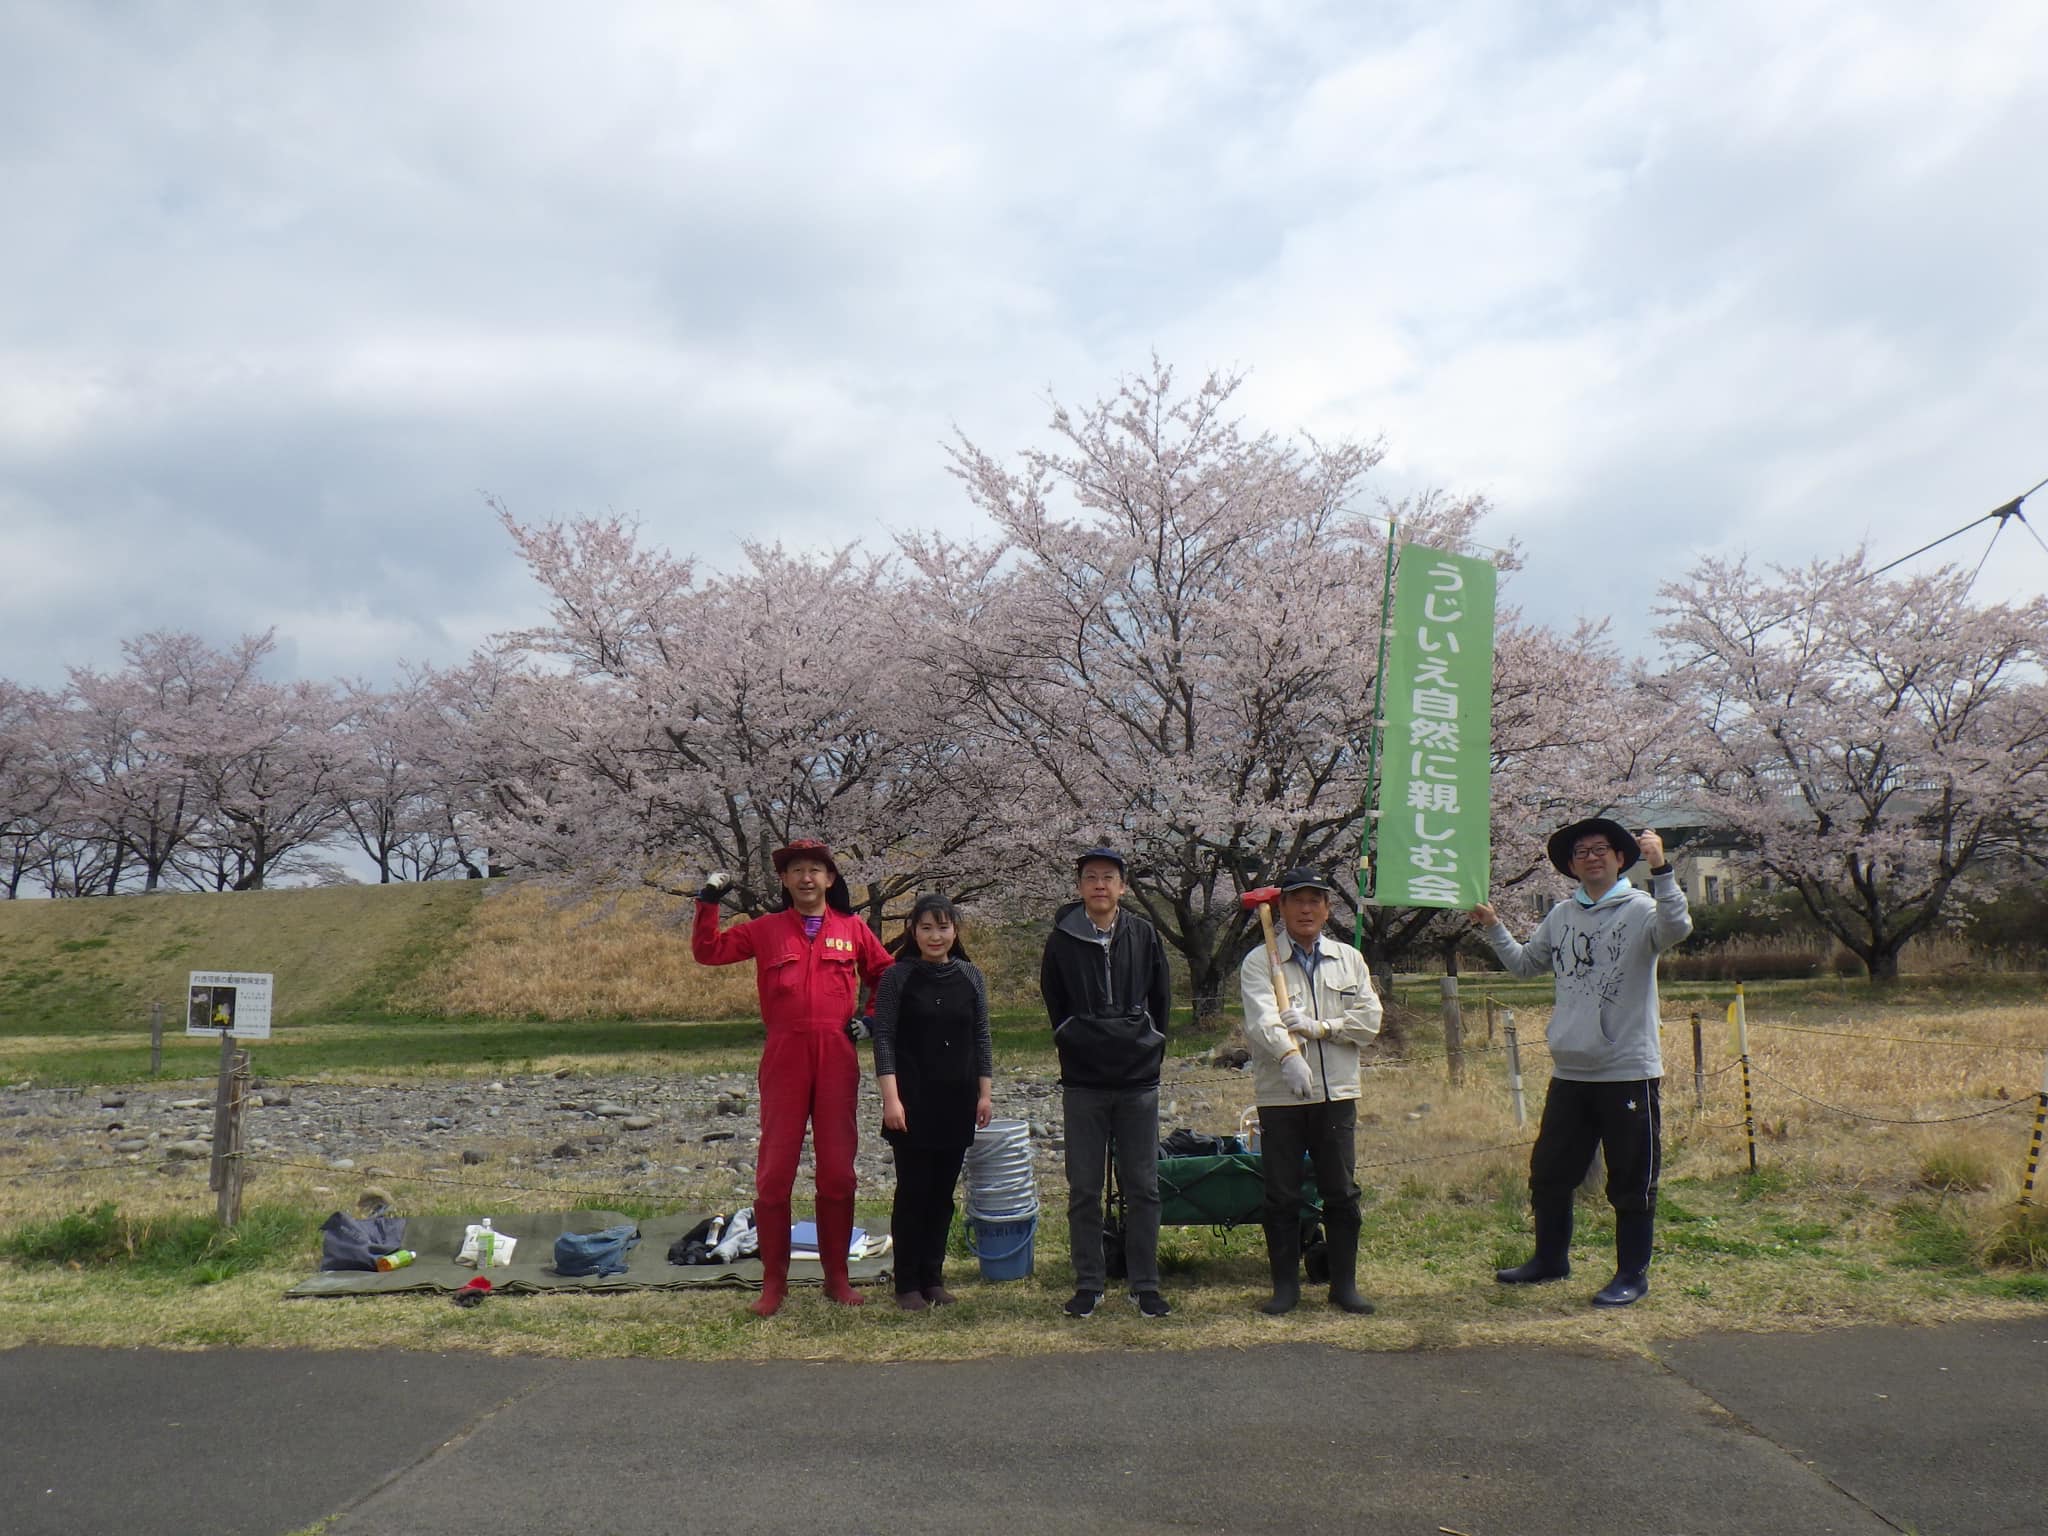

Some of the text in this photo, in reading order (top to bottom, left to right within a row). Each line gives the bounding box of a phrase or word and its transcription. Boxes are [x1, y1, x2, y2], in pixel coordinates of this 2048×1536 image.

[1408, 562, 1463, 903] うじいえ自然に親しむ会
